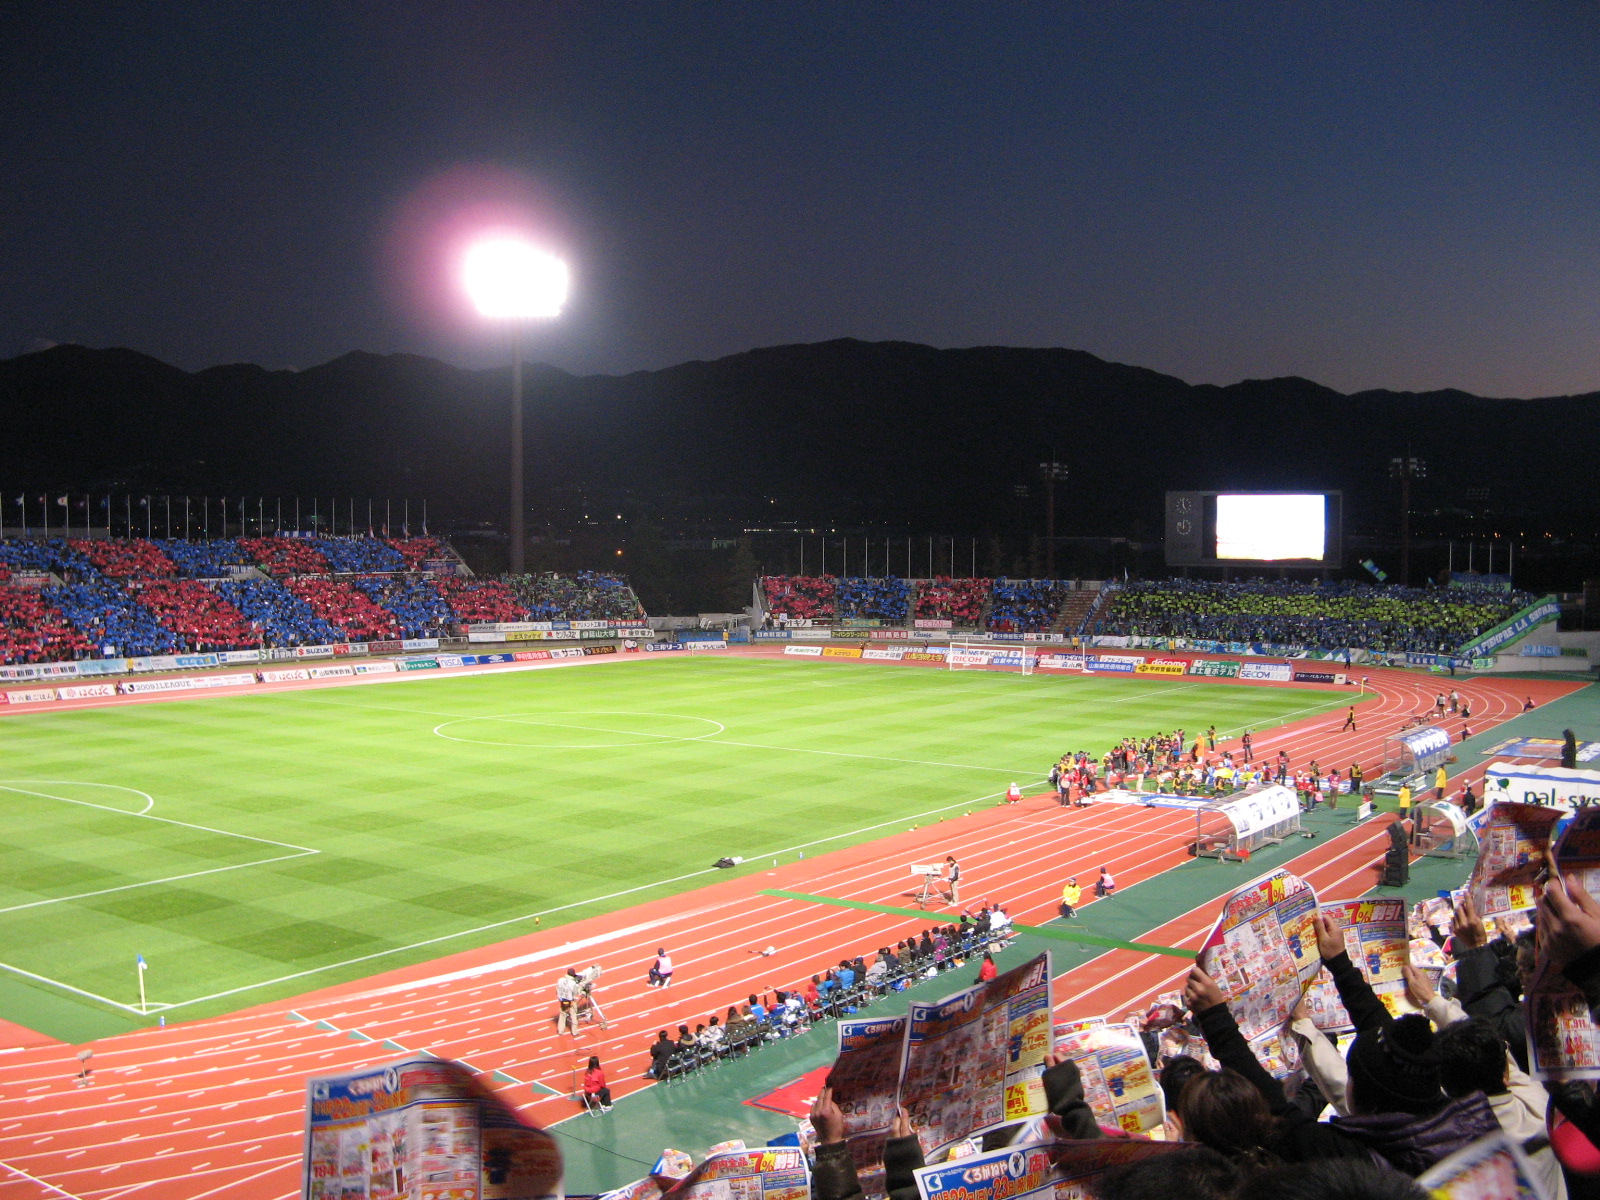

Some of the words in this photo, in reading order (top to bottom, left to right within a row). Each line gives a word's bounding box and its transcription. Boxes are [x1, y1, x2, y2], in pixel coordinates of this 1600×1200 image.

[1515, 617, 1529, 632] LA
[628, 628, 653, 637] 東京電力
[305, 646, 333, 656] SUZUKI
[653, 643, 684, 651] 三和リース
[951, 655, 983, 664] RICOH
[1151, 658, 1187, 667] docomo
[0, 668, 35, 678] 朝日新聞
[42, 665, 77, 675] 朝日新聞
[1188, 666, 1235, 676] 富士屋ホテル
[1240, 670, 1271, 679] SECOM
[278, 671, 304, 681] はくばく
[78, 686, 110, 697] はくばく
[1006, 1085, 1025, 1100] 7%
[1006, 1096, 1026, 1110] 割引
[962, 1160, 1009, 1185] くろがねや
